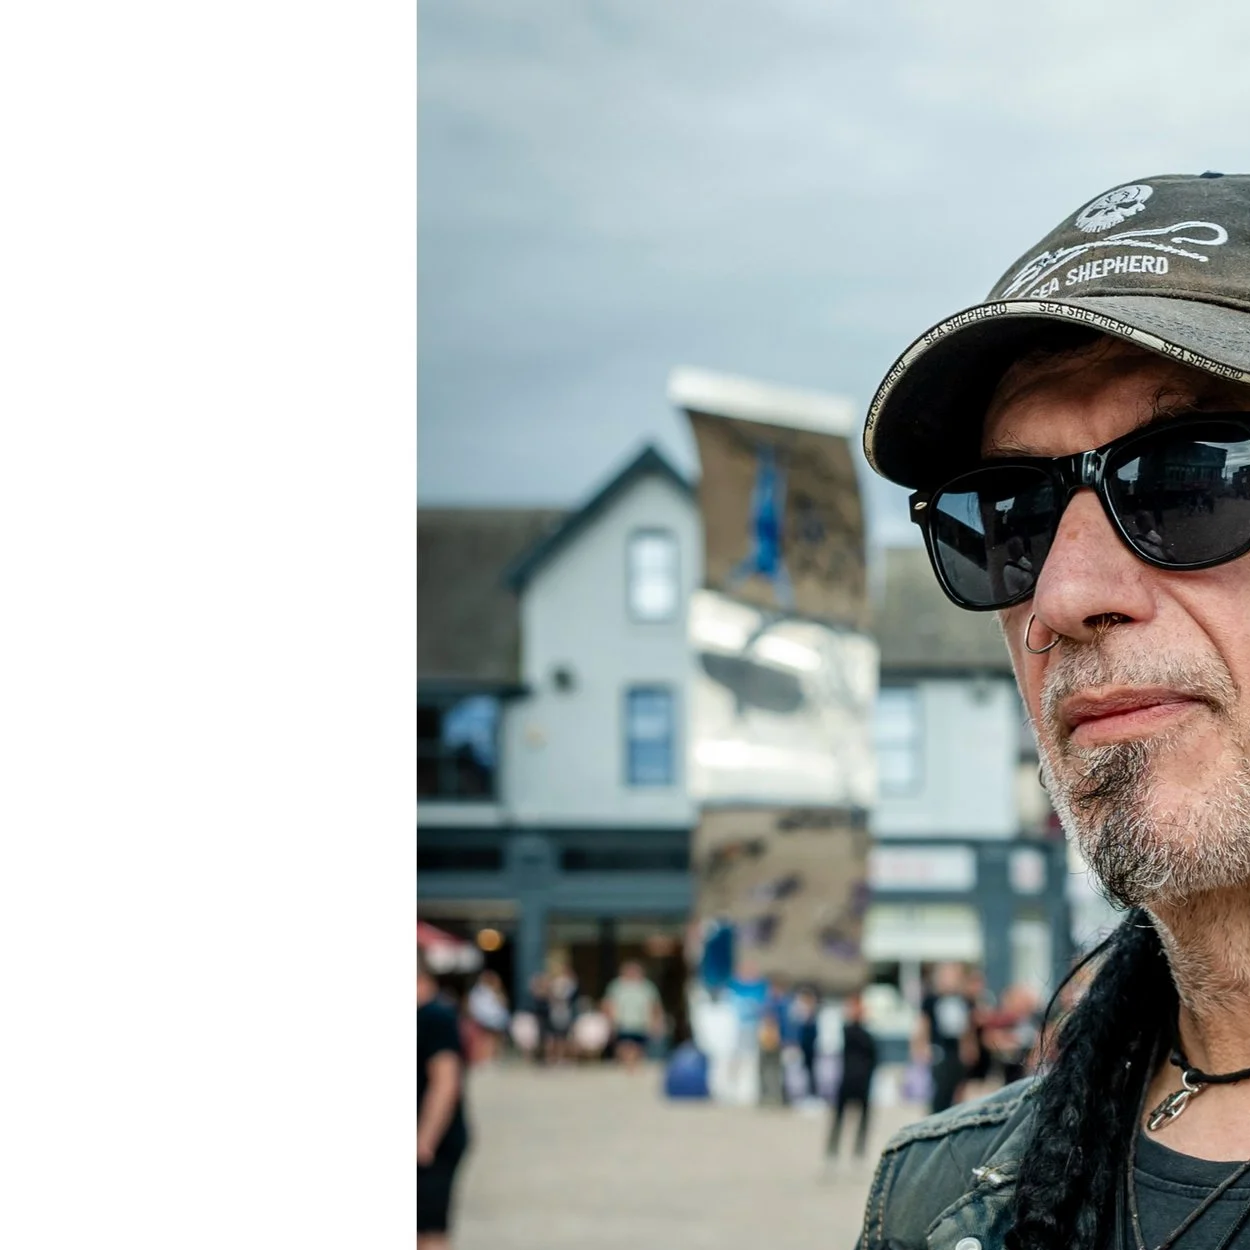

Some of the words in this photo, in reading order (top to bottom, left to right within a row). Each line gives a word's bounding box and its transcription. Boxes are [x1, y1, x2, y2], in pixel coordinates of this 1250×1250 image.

[1031, 278, 1059, 299] SEA
[1065, 255, 1169, 287] SHEPHERD
[923, 326, 945, 346] SEA
[945, 303, 1008, 332] SHEPHERD
[1038, 301, 1063, 315] SEA
[1066, 305, 1135, 337] SHEPHERD
[1160, 341, 1187, 361] SEA
[1186, 352, 1244, 382] SHEPHERD
